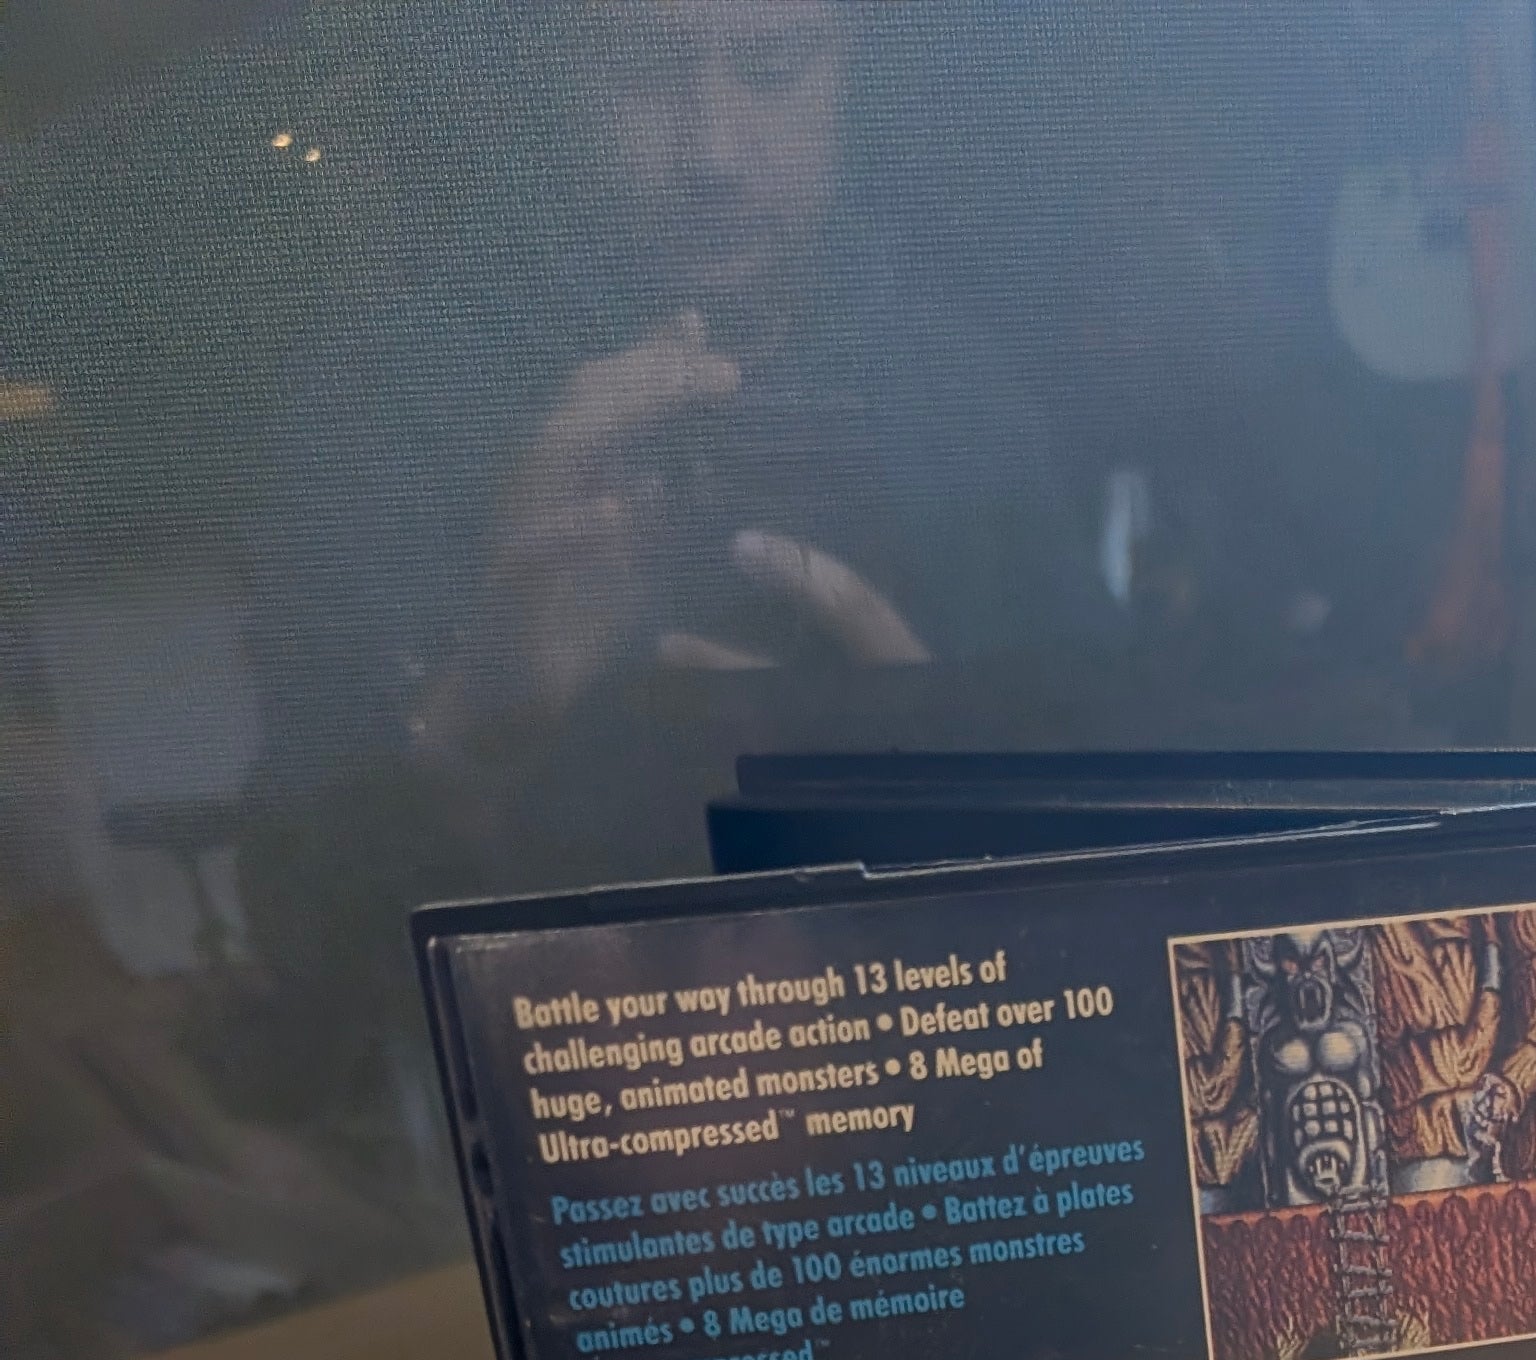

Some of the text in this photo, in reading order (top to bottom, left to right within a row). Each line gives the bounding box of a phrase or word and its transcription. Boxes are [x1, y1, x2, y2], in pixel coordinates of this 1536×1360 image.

[514, 950, 1005, 1028] Battle your way through 13 levels of
[524, 986, 1113, 1074] challenging arcade action Defeat over 100
[530, 1038, 1042, 1121] huge, animated monsters 8 Mega of
[806, 1105, 914, 1134] memory
[551, 1196, 643, 1224] Passez
[650, 1188, 710, 1213] avec
[717, 1172, 800, 1206] succès
[805, 1167, 844, 1196] les
[854, 1160, 885, 1190] 13
[893, 1157, 995, 1186] niveaux
[560, 1181, 1133, 1268] stimulantes de type arcade Battez à plates
